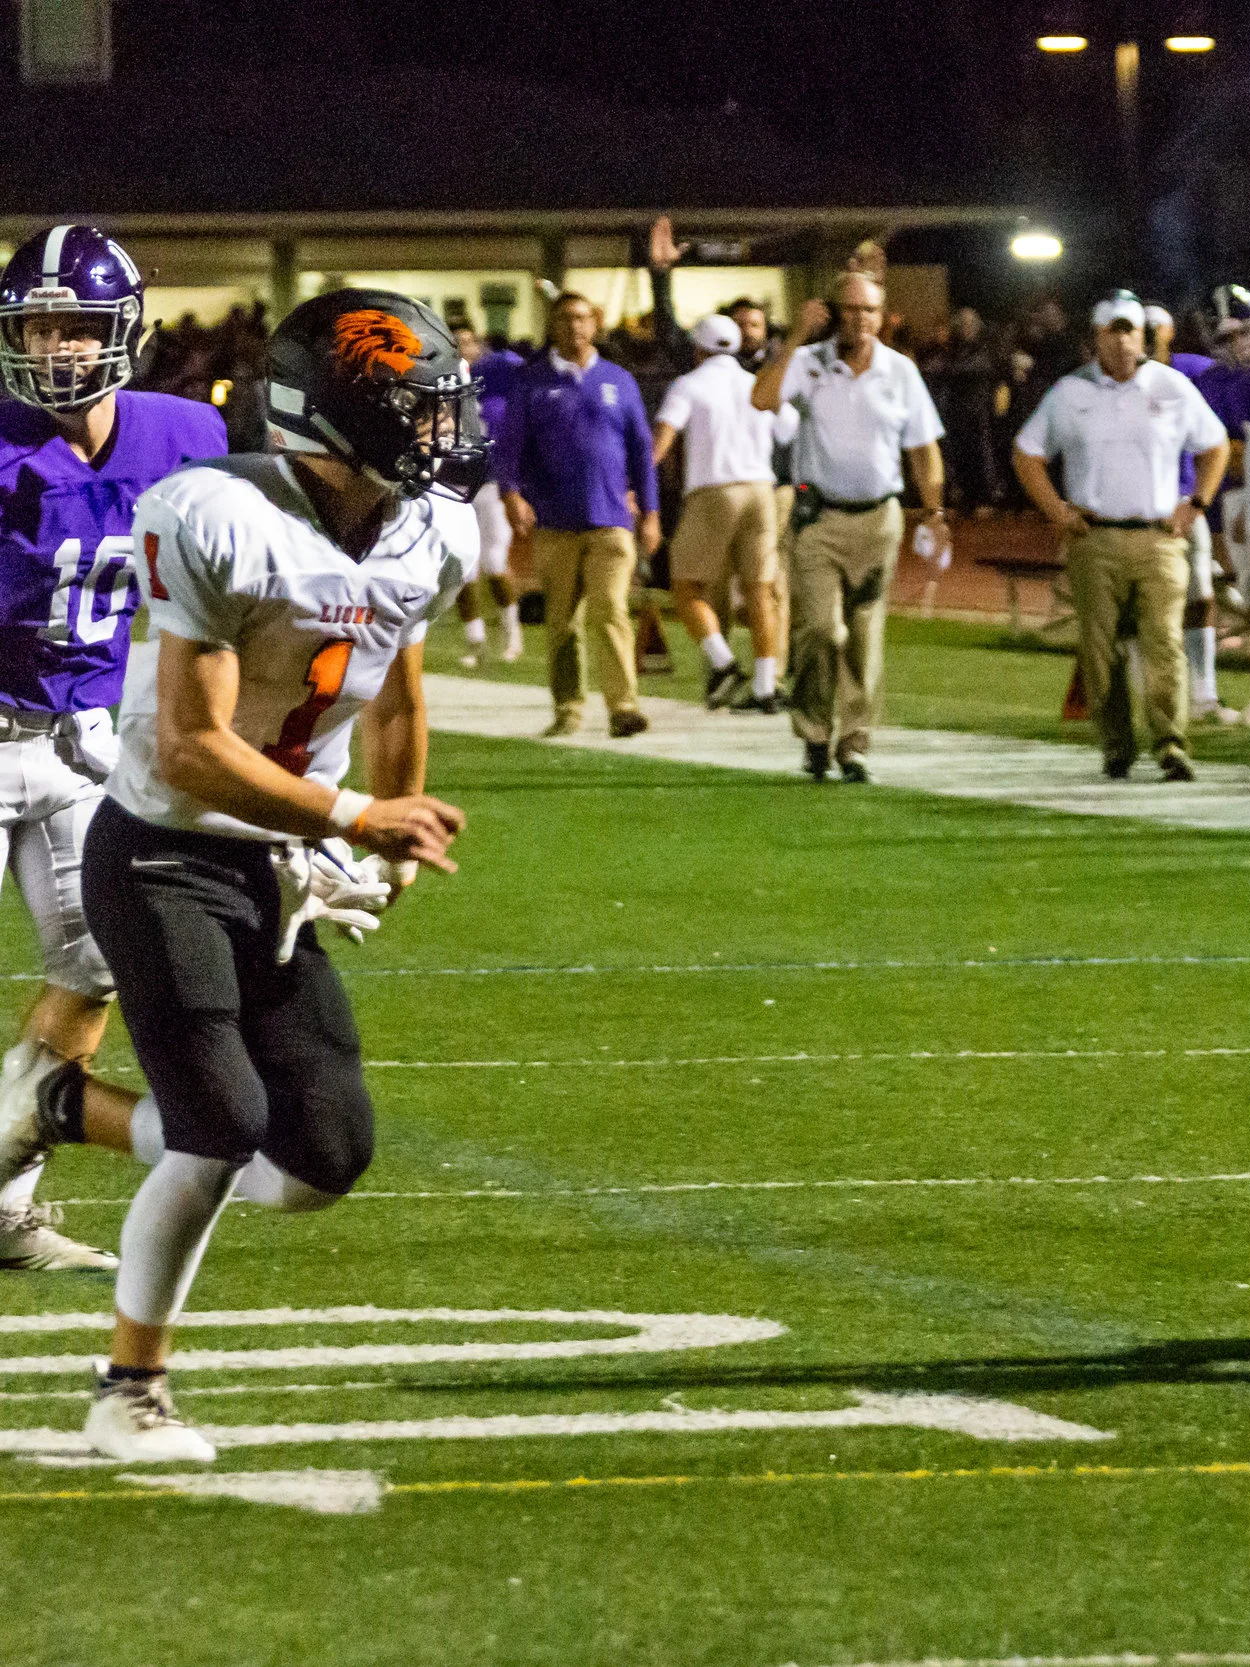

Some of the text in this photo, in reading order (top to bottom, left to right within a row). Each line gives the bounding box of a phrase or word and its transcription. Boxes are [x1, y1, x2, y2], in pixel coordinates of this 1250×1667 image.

[31, 290, 68, 299] Riddell
[46, 535, 136, 646] 10
[143, 531, 170, 601] 1
[319, 603, 377, 625] LIONS
[262, 637, 355, 778] 1
